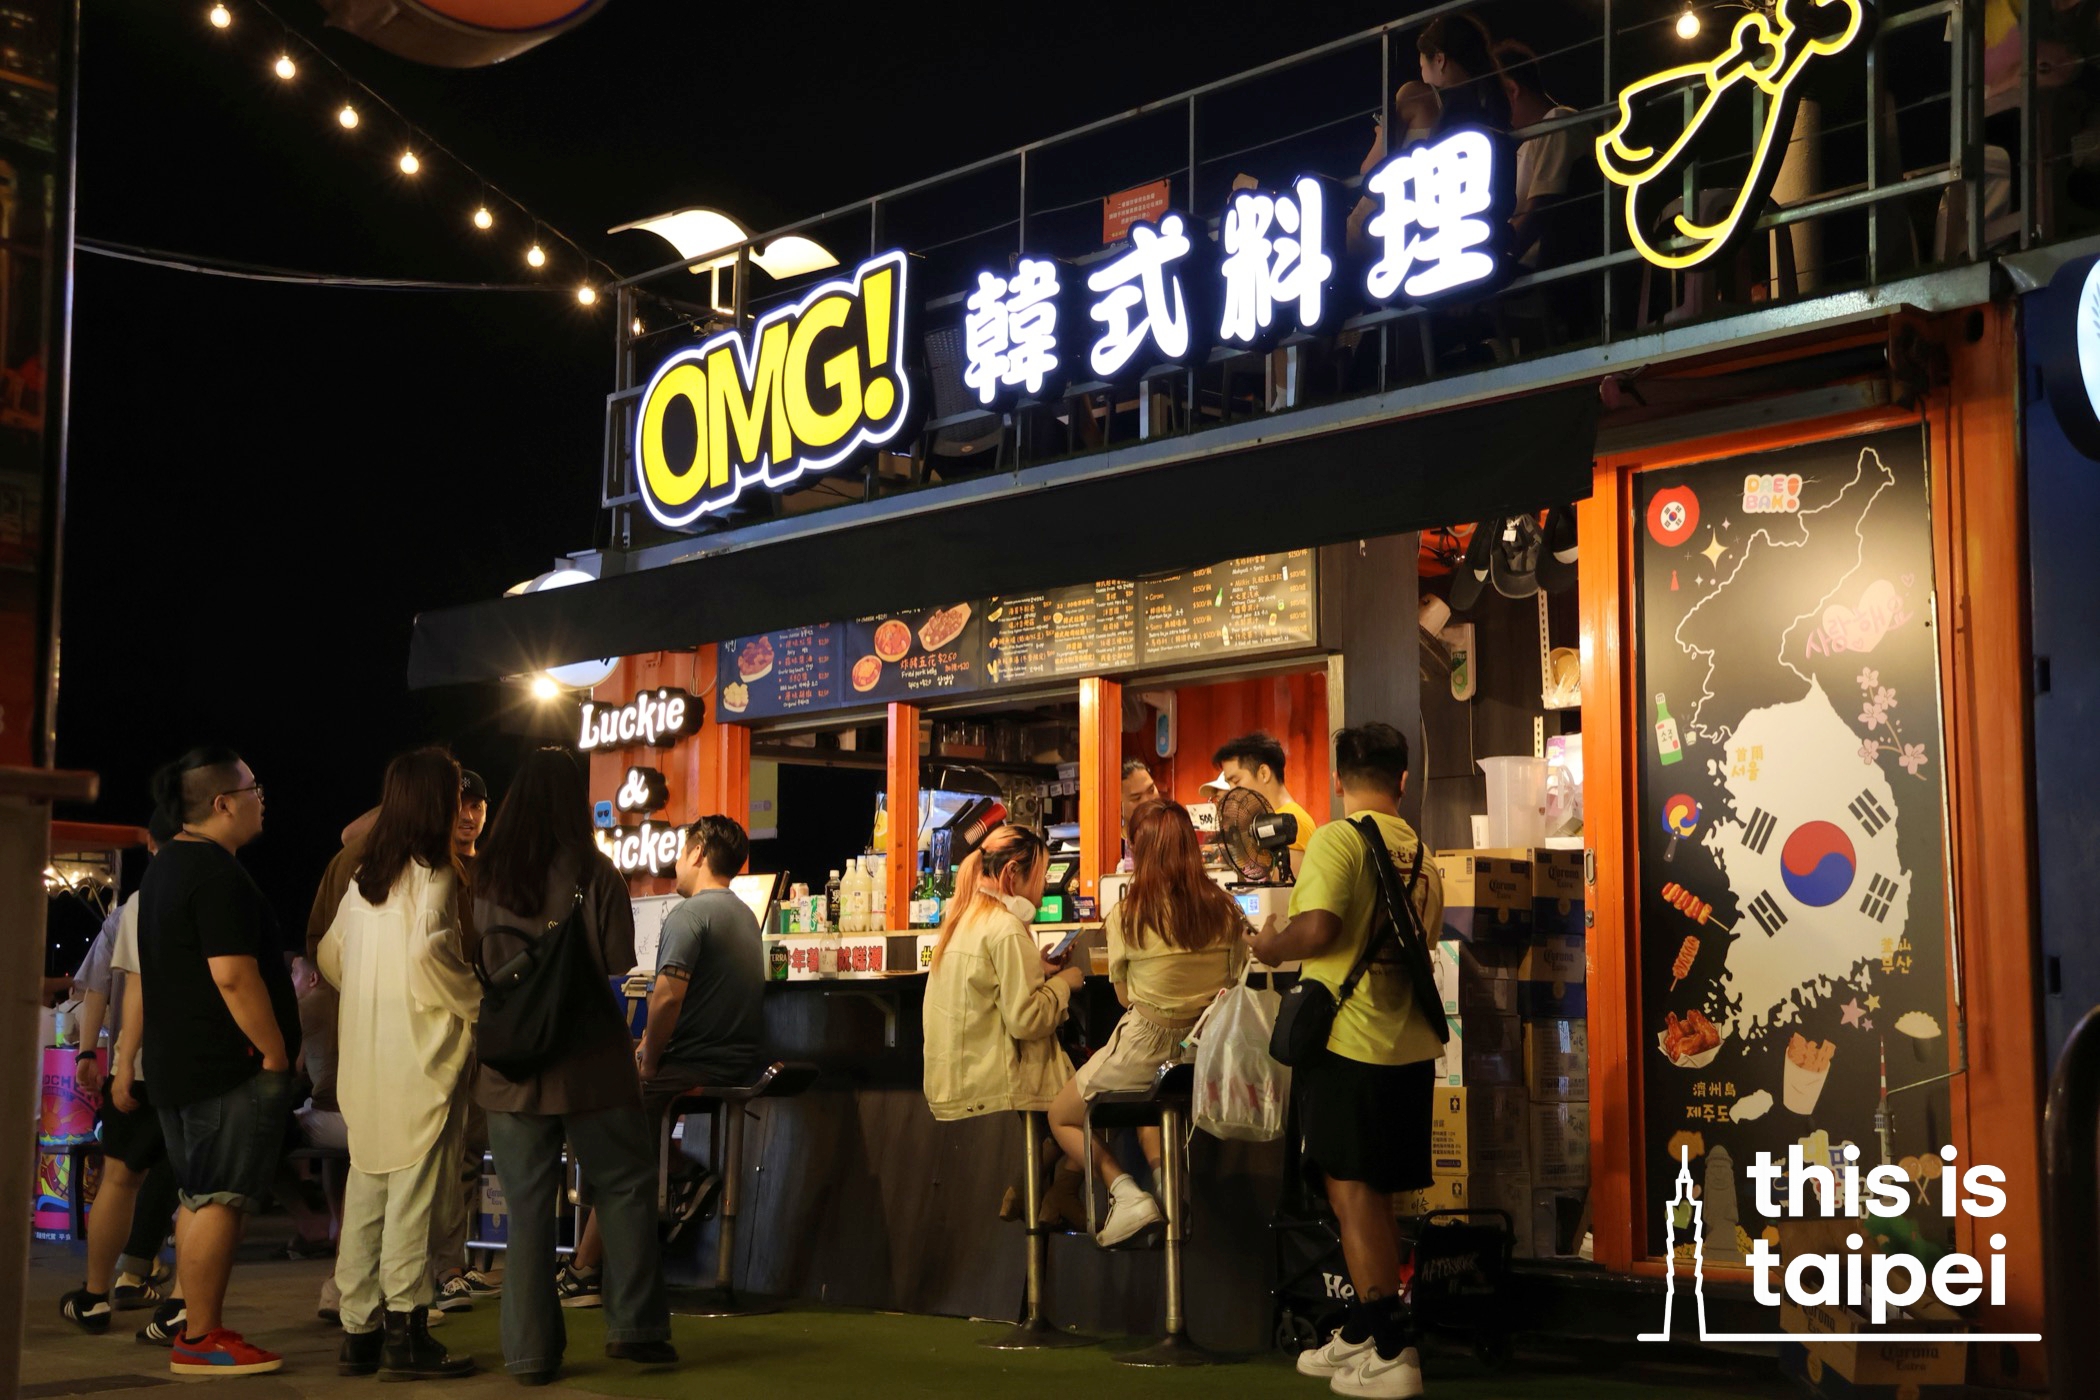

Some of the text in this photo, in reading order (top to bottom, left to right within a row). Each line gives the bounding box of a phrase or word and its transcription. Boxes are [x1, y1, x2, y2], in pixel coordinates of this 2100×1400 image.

[963, 130, 1494, 405] 韓式料理
[642, 267, 895, 506] OMG!
[1747, 477, 1785, 494] DAE
[578, 689, 685, 749] Luckie
[1730, 761, 1760, 782] 서울
[617, 769, 649, 809] &
[1199, 812, 1213, 826] 500
[592, 823, 690, 877] hicke
[1548, 864, 1580, 880] Corona
[1489, 879, 1517, 893] Corona
[770, 953, 788, 962] TERRA
[1543, 949, 1575, 963] Corona
[1880, 955, 1913, 975] 부산
[1692, 1081, 1737, 1098] 濟州島
[1686, 1103, 1730, 1123] 제주도
[1880, 1344, 1939, 1361] Corona
[1896, 1359, 1927, 1371] Extra
